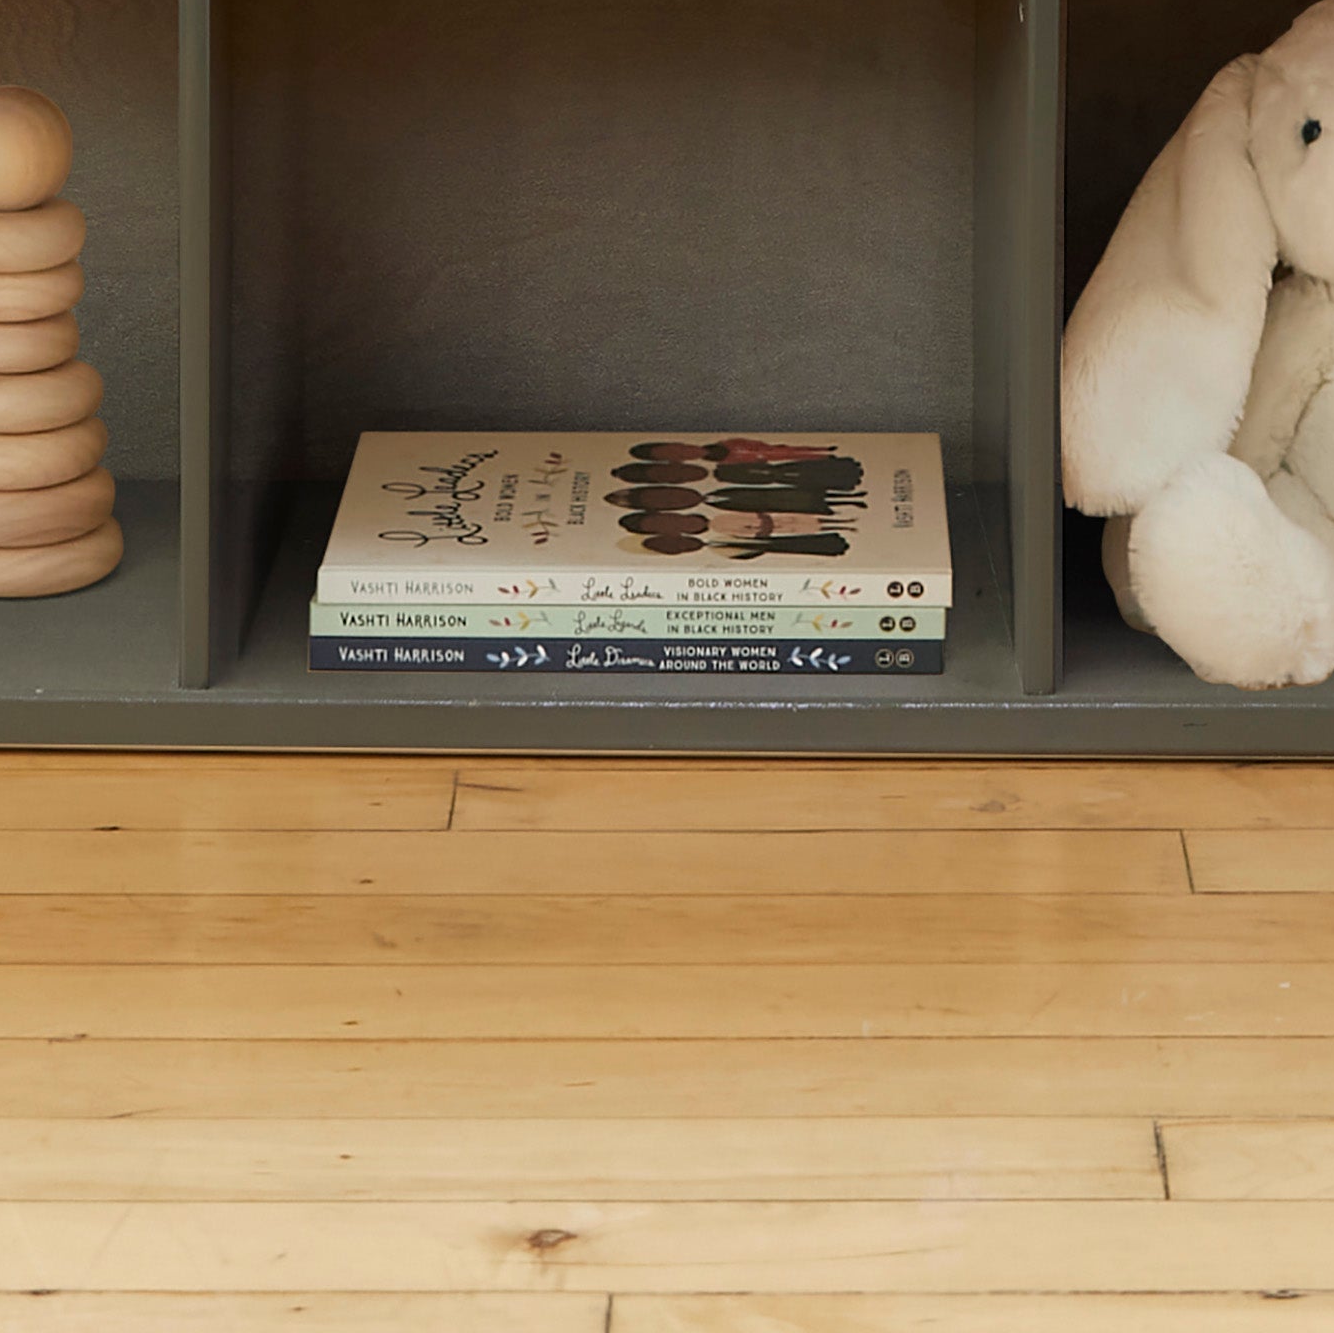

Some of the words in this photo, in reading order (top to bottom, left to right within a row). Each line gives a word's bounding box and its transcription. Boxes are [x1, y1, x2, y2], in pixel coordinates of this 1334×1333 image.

[381, 450, 498, 501] Leaders
[378, 502, 488, 548] Little
[351, 581, 397, 595] VASHTI
[405, 582, 473, 594] HARRISON
[688, 579, 719, 588] BOLD
[723, 579, 768, 588] WOMEN
[677, 593, 688, 601] IN
[693, 593, 725, 601] BLACK
[731, 593, 783, 601] HISTORY
[340, 612, 389, 627] VASHTI
[397, 612, 467, 627] HARRISON
[666, 611, 745, 621] EXCEPTIONAL
[750, 611, 775, 620] MEN
[667, 625, 679, 633] IN
[684, 625, 717, 633] BLACK
[723, 625, 774, 634] HISTORY
[339, 647, 387, 662] VASHTI
[395, 647, 464, 663] HARRISON
[663, 646, 727, 656] VISIONARY
[731, 647, 776, 656] WOMEN
[659, 660, 707, 670] AROUND
[711, 660, 734, 670] THE
[739, 660, 780, 670] WORLD
